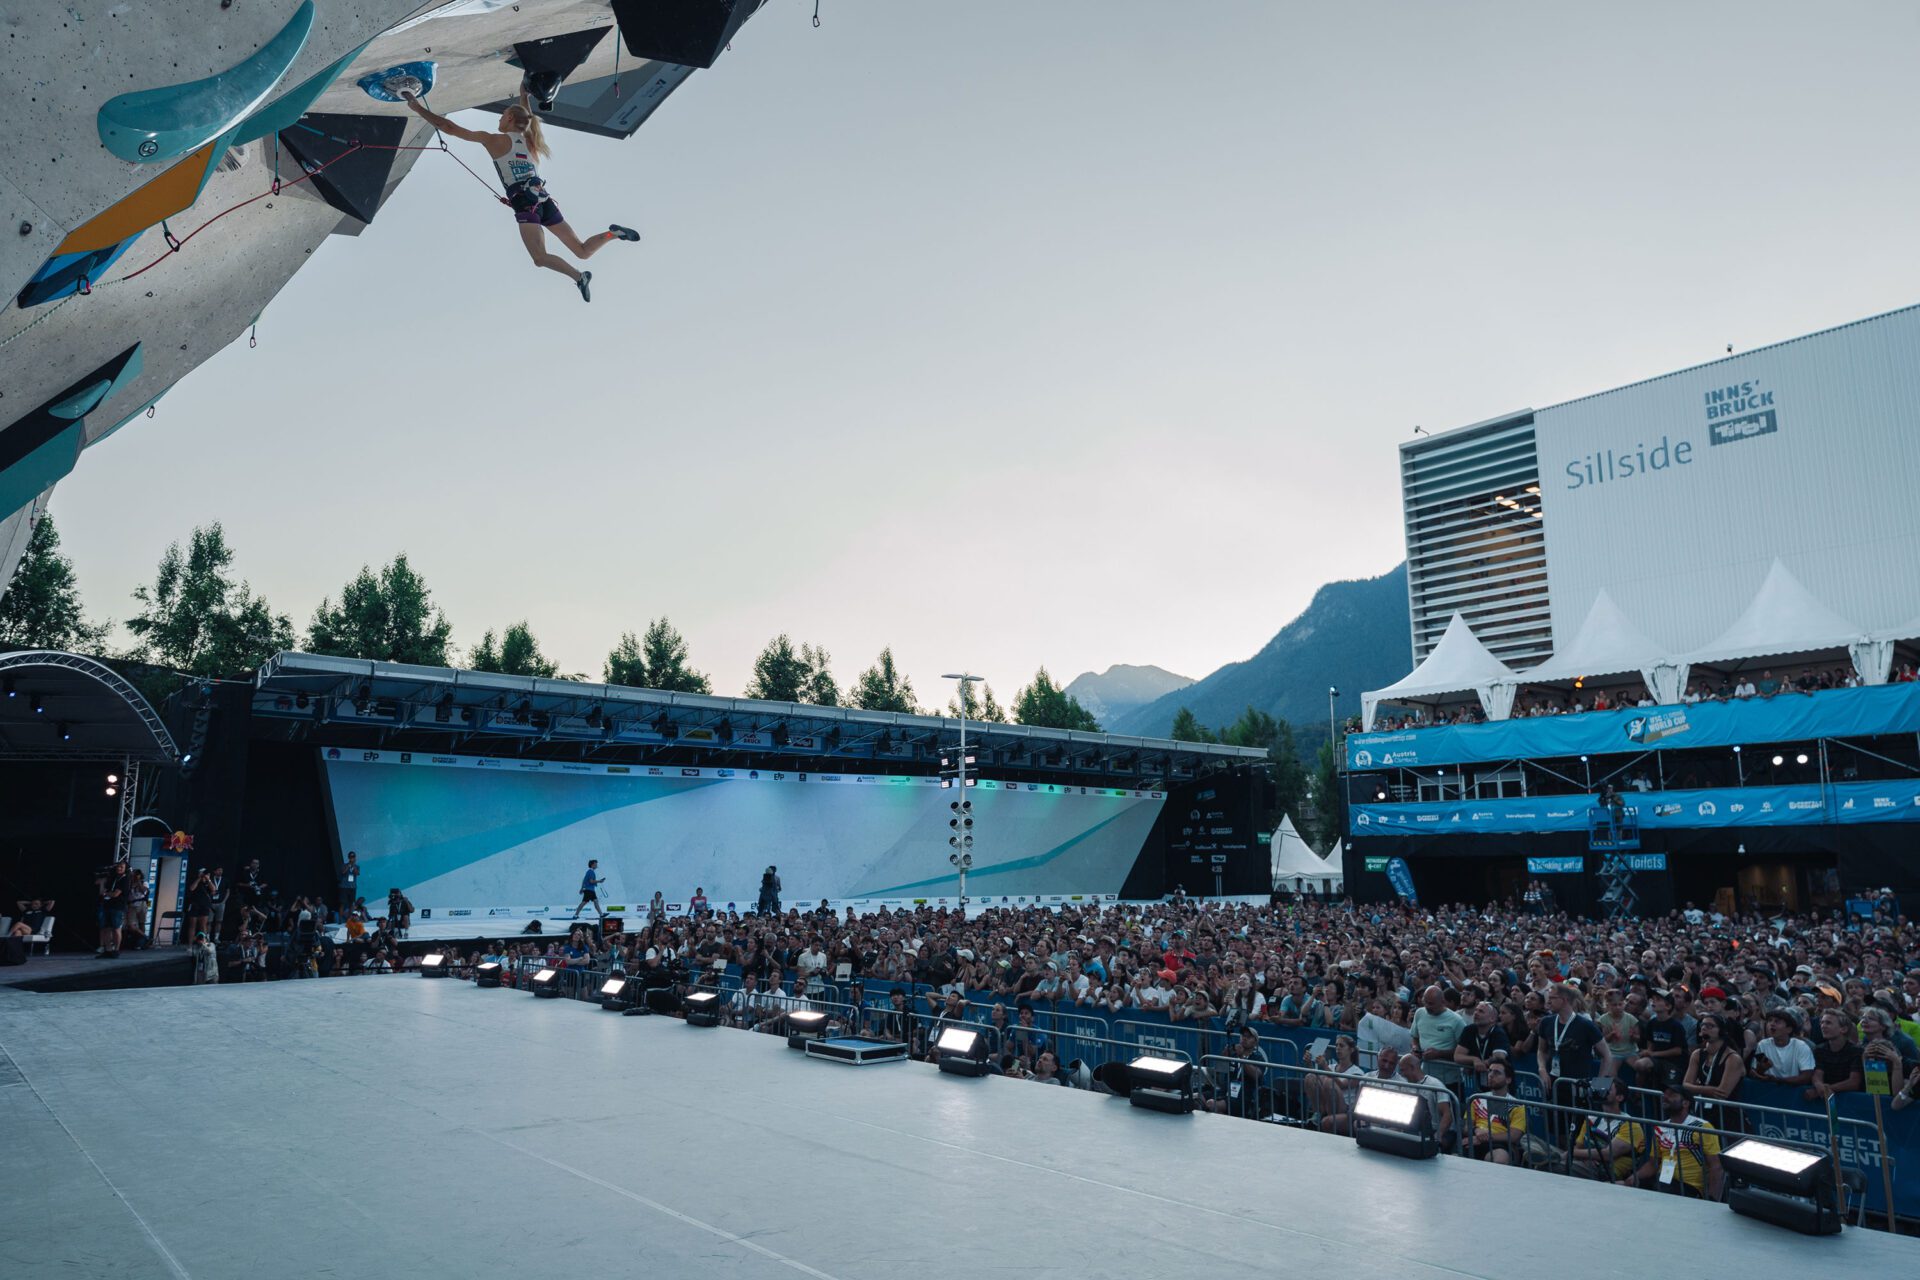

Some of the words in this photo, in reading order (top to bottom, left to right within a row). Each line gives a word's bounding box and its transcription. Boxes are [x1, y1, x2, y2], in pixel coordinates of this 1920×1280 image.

[1706, 391, 1775, 419] BRUCK
[1714, 415, 1767, 438] Tirol
[1565, 435, 1693, 490] Sillside
[1648, 719, 1673, 732] WORLD
[1673, 715, 1687, 726] CUP
[1392, 750, 1417, 758] Austria
[1630, 855, 1663, 869] Toilets
[1518, 1081, 1542, 1098] fan
[1785, 1127, 1881, 1152] PERFECT
